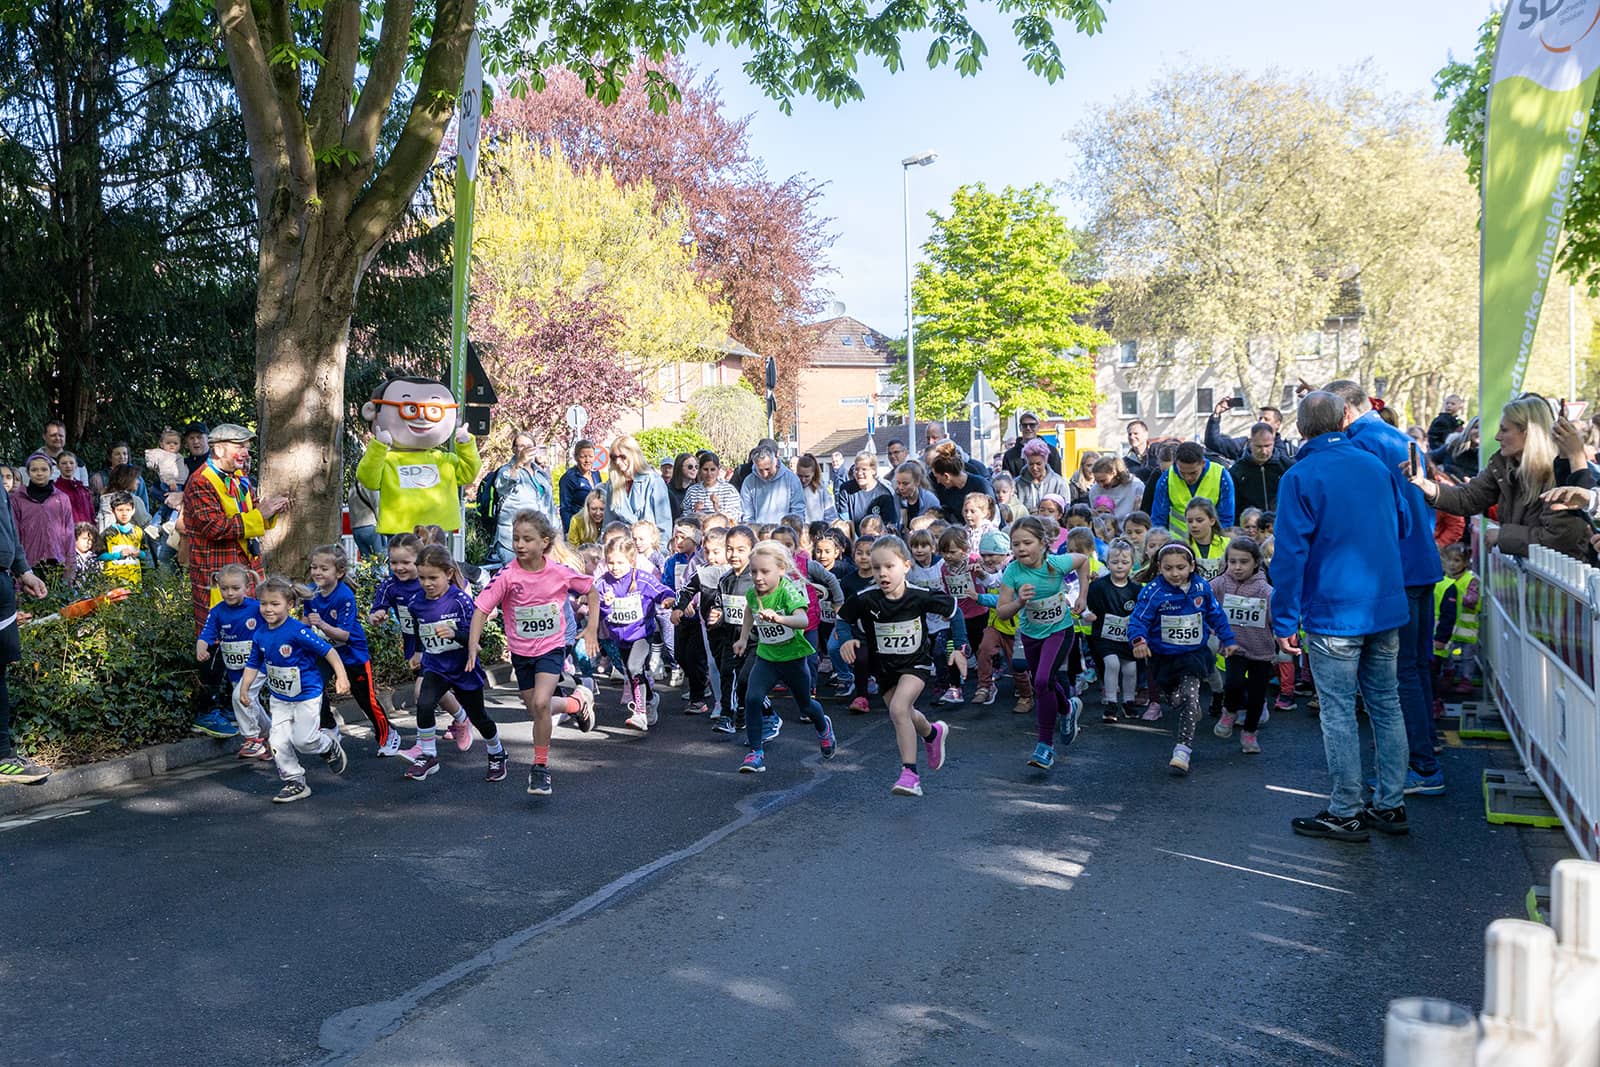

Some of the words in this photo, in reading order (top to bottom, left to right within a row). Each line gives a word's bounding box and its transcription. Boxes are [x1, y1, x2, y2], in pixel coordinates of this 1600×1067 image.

[400, 466, 422, 476] SD
[612, 610, 638, 621] 4098
[1032, 605, 1063, 620] 2258
[1229, 608, 1260, 622] 1516
[522, 617, 555, 633] 2993
[759, 624, 786, 638] 1889
[1168, 627, 1199, 640] 2556
[883, 634, 916, 648] 2721
